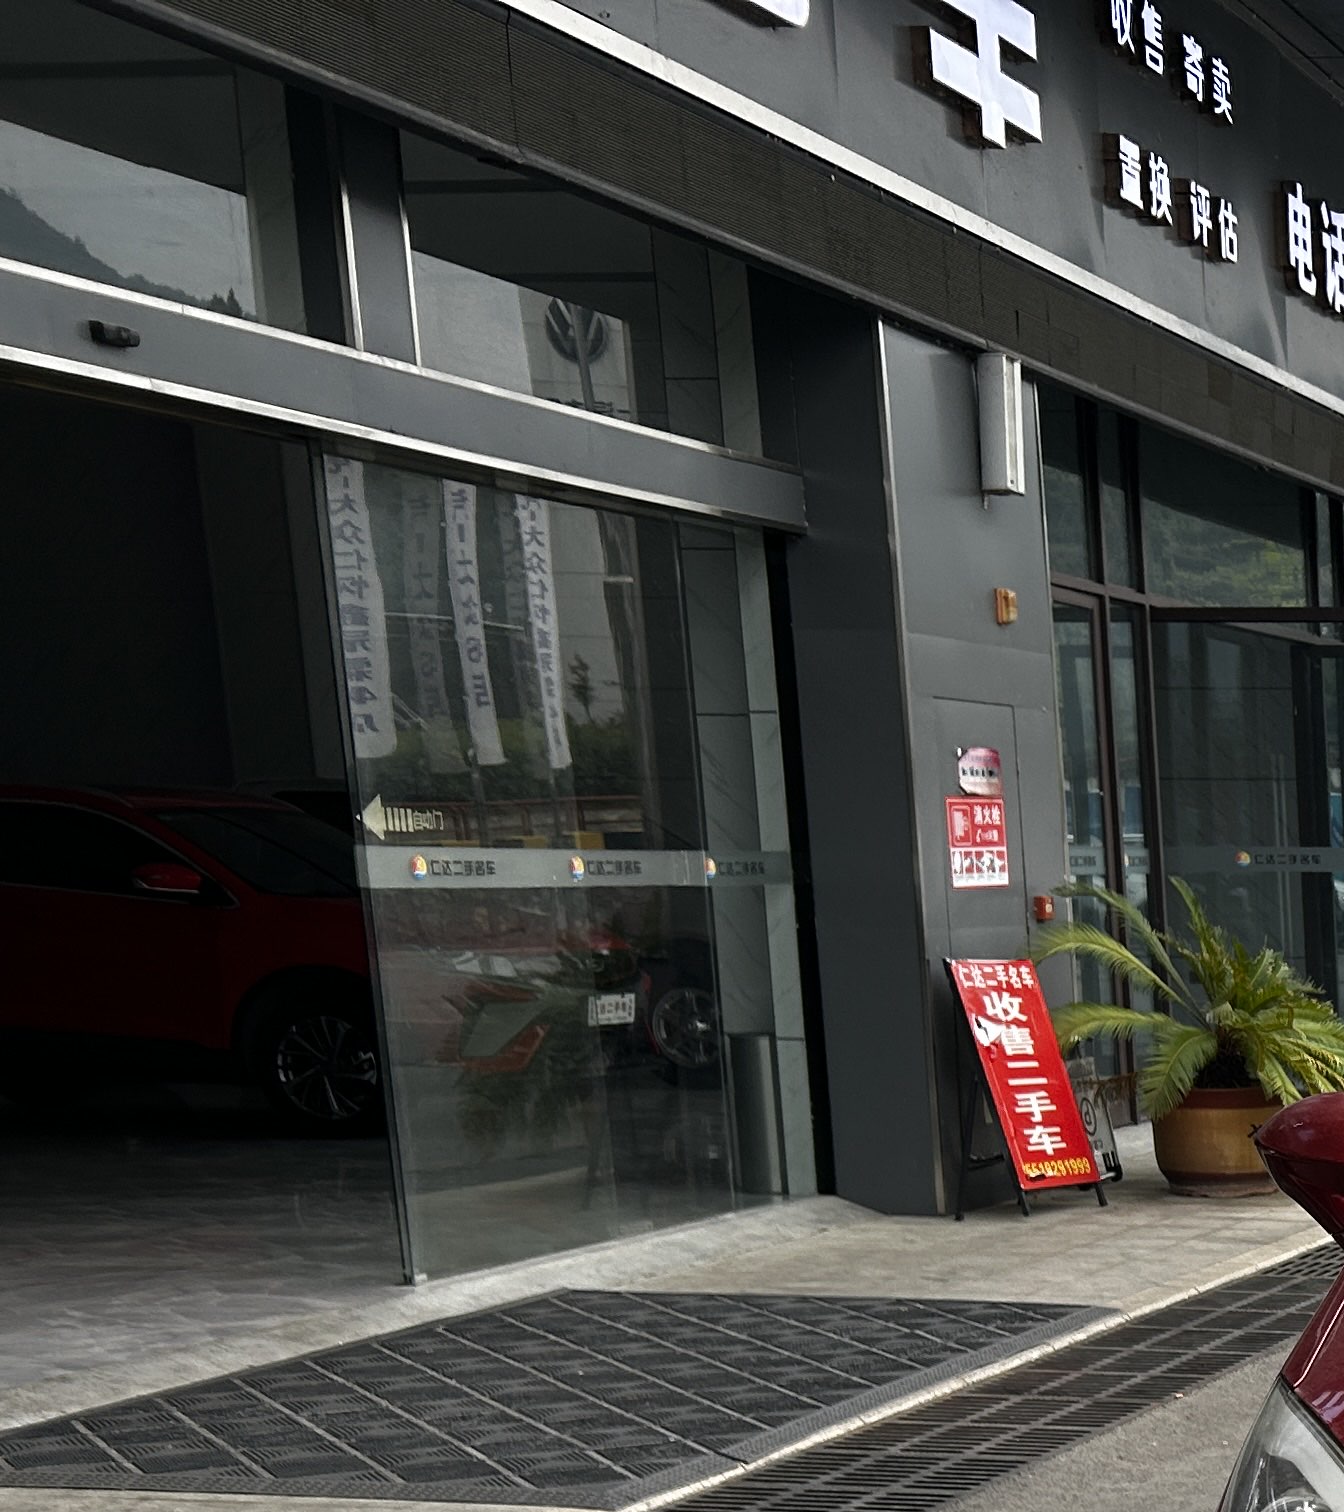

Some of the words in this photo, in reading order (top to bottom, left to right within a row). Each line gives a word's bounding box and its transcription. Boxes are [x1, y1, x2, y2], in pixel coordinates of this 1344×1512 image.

[1183, 33, 1234, 125] 寄卖
[1119, 134, 1173, 226] 置换
[1190, 182, 1238, 263] 评估
[430, 858, 497, 877] 仁达二手名车
[958, 964, 1035, 989] 仁达二手名车
[982, 991, 1067, 1155] 收售二手车
